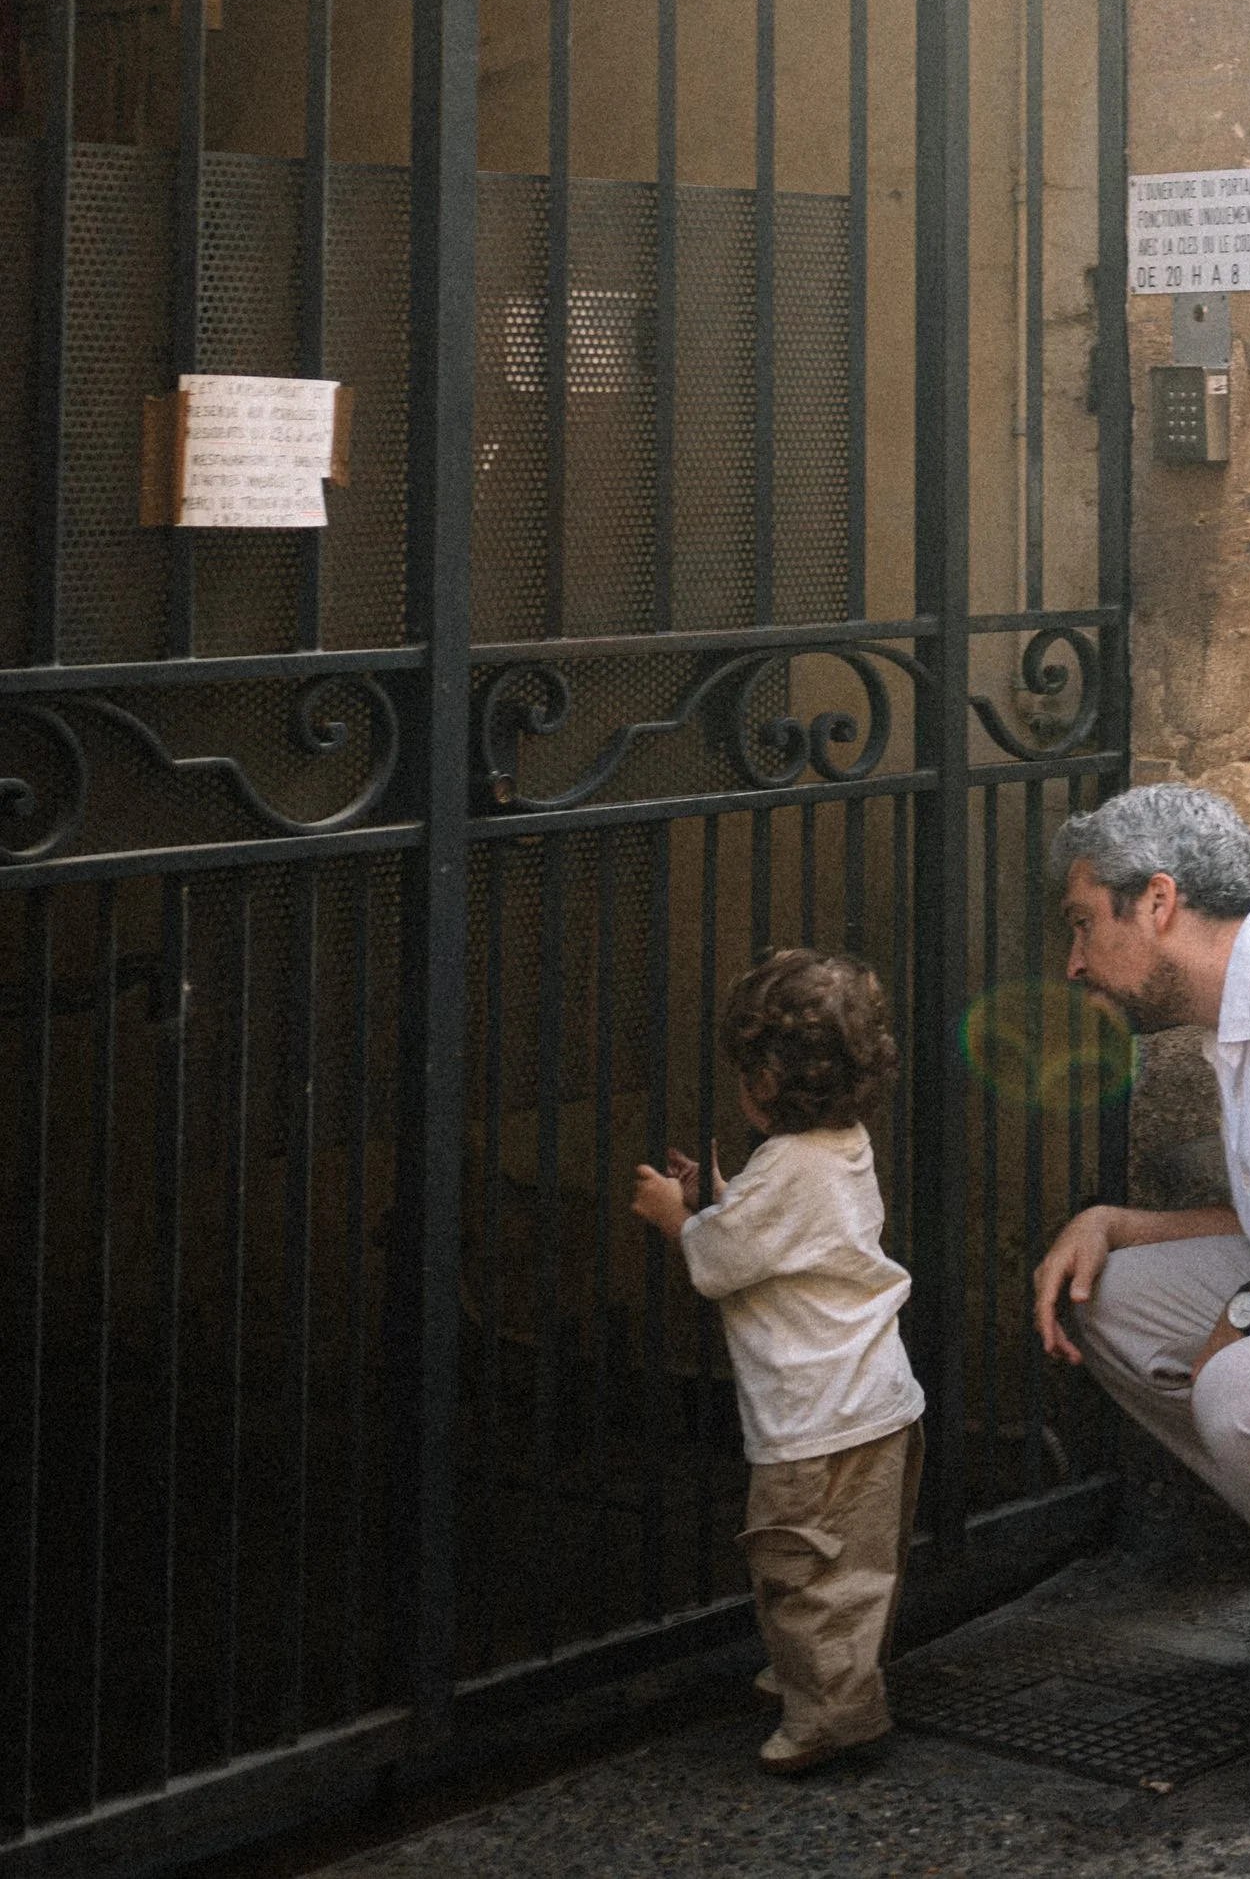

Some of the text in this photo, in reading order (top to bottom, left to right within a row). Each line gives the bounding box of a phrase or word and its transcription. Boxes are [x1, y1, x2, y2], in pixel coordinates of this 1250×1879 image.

[1201, 179, 1216, 198] DU
[1137, 208, 1193, 229] FONCTIONNE
[1137, 237, 1158, 256] AVEC
[1162, 237, 1174, 256] LA
[1203, 236, 1215, 254] OU
[1219, 234, 1230, 253] LE
[1136, 266, 1156, 288] DE
[1165, 265, 1183, 287] 20
[1191, 264, 1202, 286] H
[1211, 264, 1223, 286] A
[1231, 263, 1240, 285] 8
